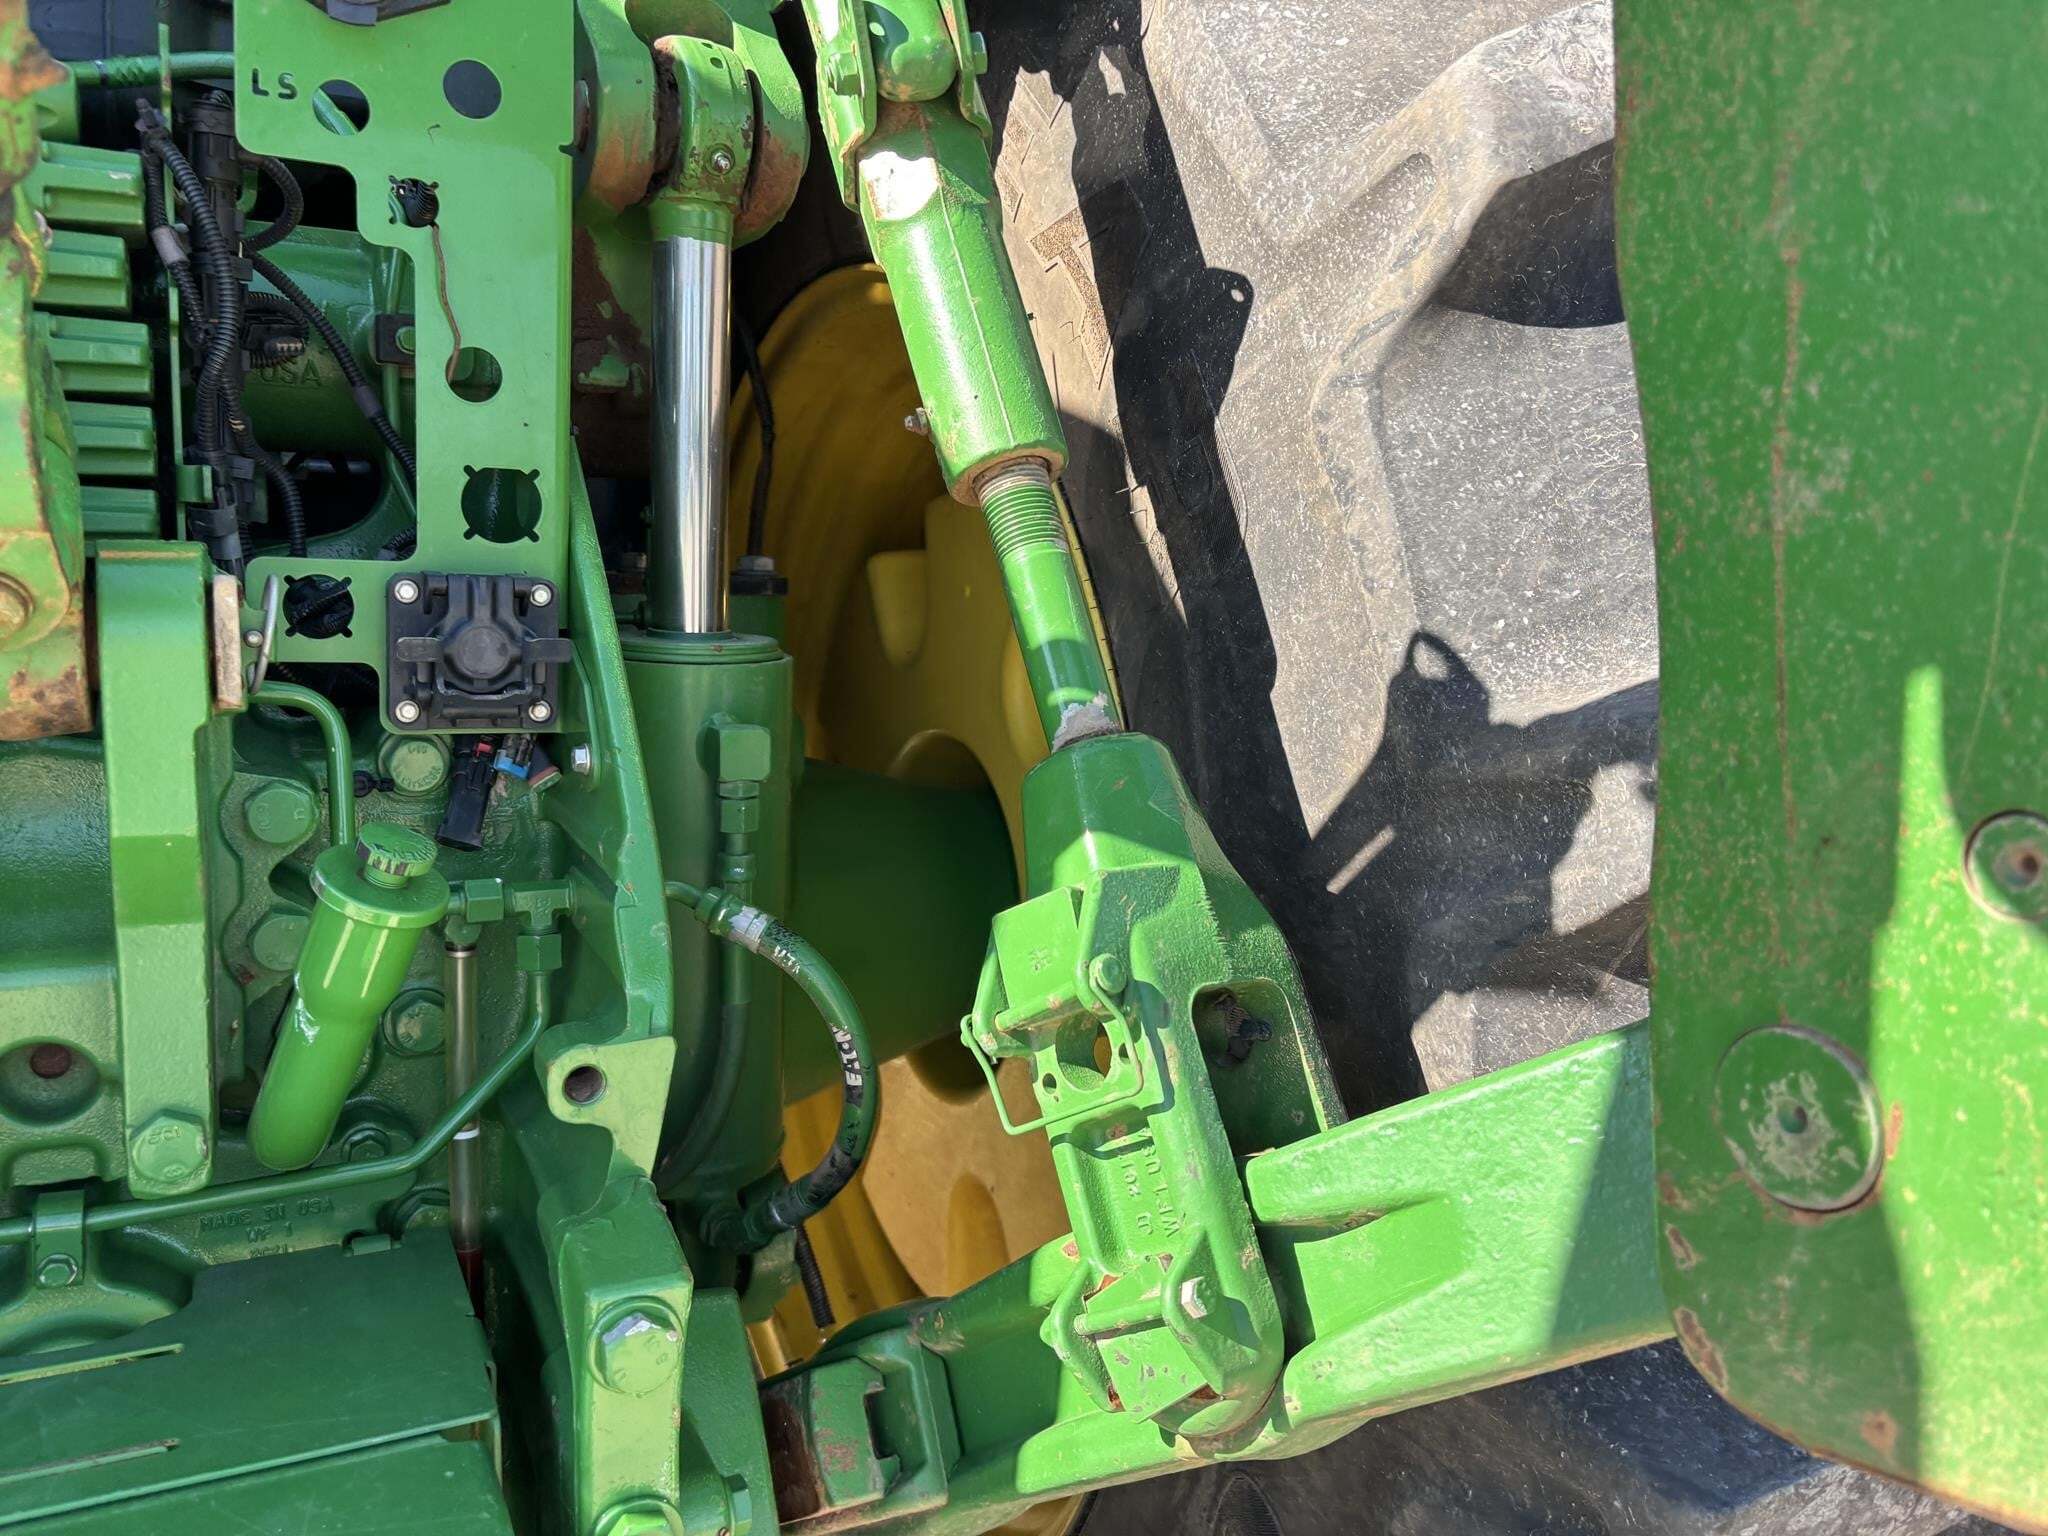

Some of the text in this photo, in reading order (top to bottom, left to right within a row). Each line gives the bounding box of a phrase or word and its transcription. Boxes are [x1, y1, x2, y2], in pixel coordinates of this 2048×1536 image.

[251, 67, 298, 100] LS
[200, 1197, 335, 1231] MADE IN USA
